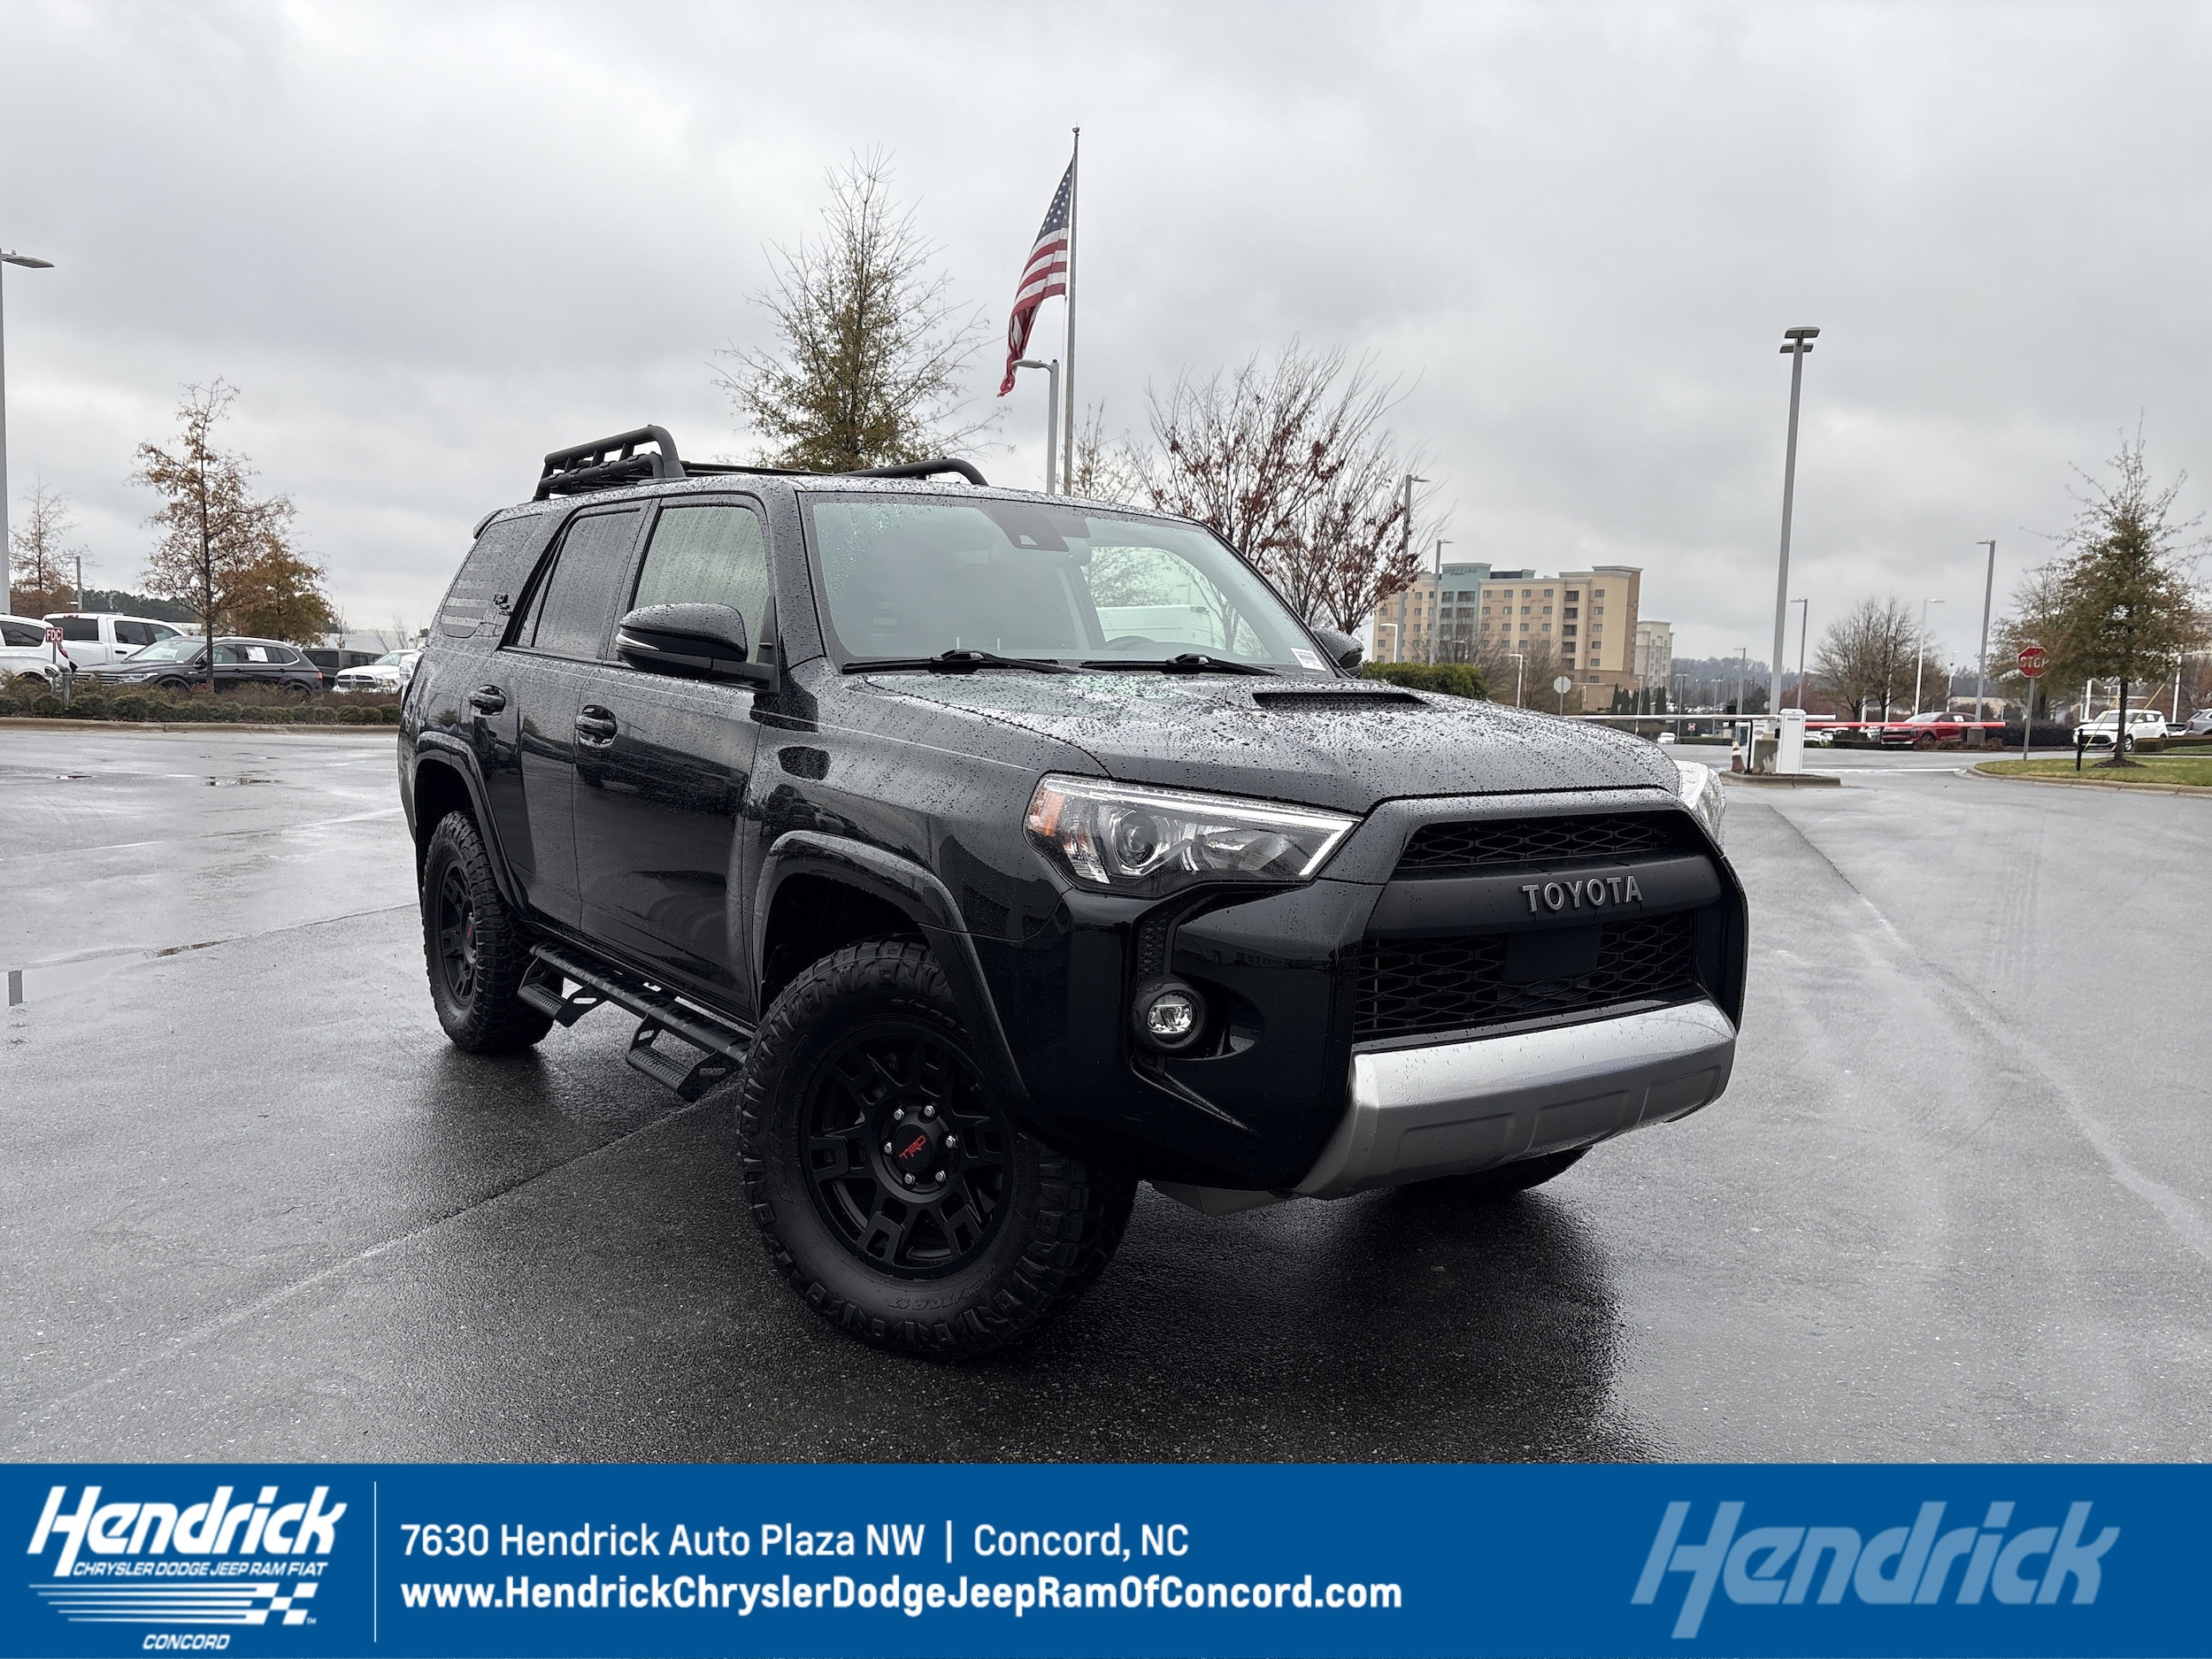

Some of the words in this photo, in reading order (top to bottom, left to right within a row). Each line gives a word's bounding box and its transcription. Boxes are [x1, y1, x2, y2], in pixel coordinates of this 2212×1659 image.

[47, 629, 62, 641] FDC
[2020, 657, 2049, 668] STOP
[1521, 875, 1643, 913] TOYOTA
[899, 1134, 926, 1159] TRD
